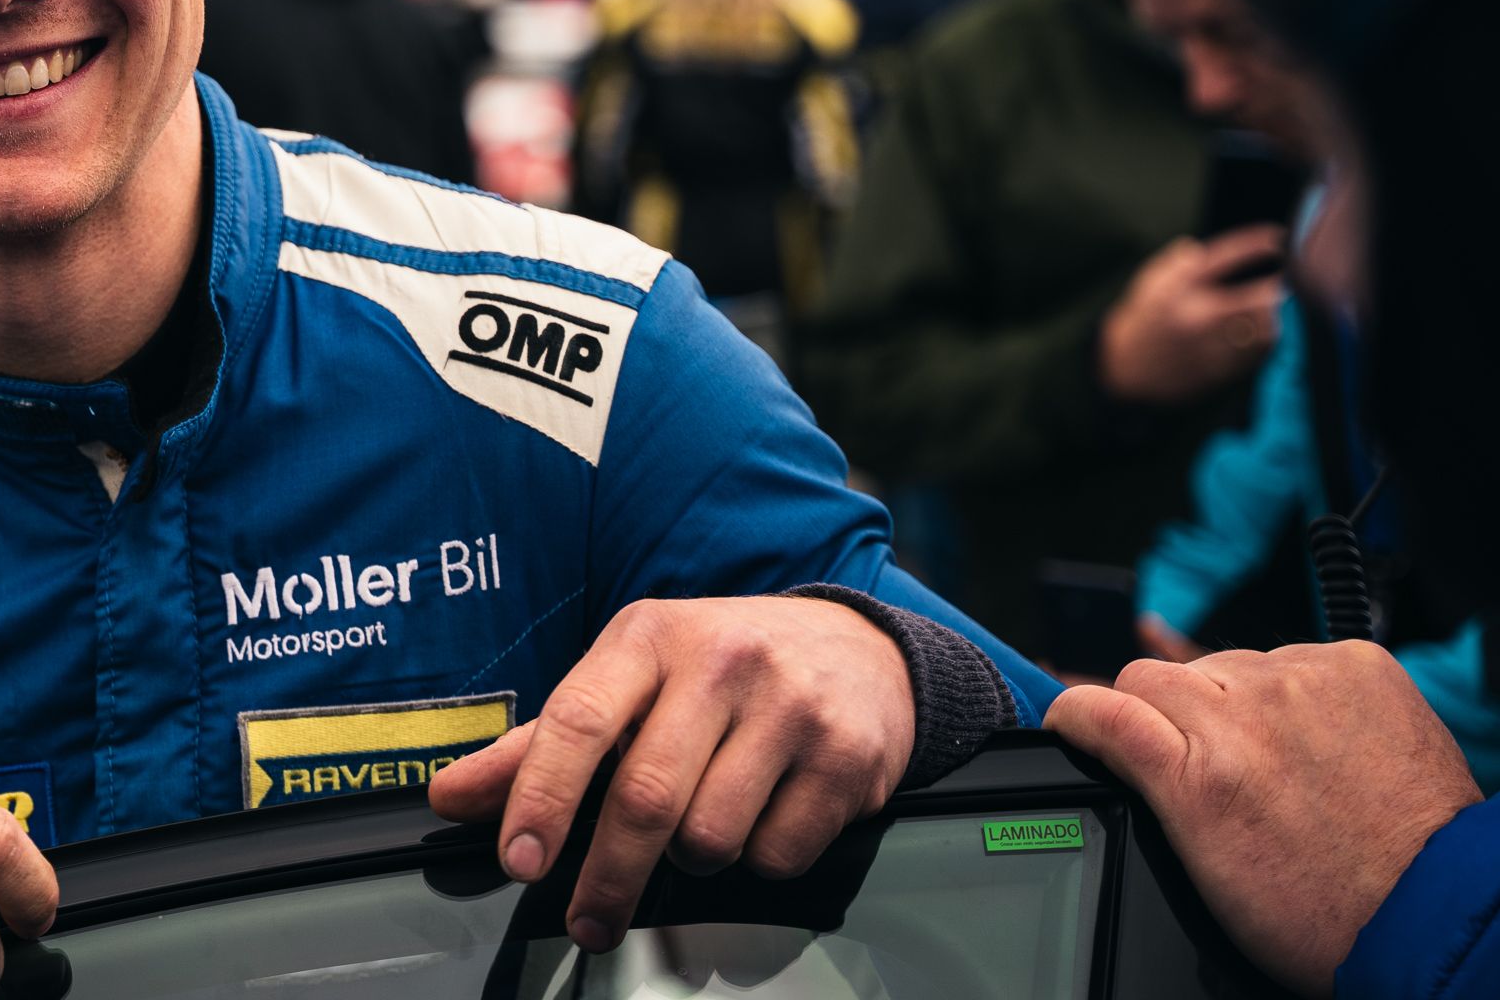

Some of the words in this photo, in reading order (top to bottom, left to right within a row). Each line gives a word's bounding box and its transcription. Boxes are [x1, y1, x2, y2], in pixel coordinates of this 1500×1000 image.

[459, 303, 603, 382] OMP
[440, 533, 500, 596] Bil
[226, 621, 387, 663] Motorsport
[988, 823, 1080, 841] LAMINADO
